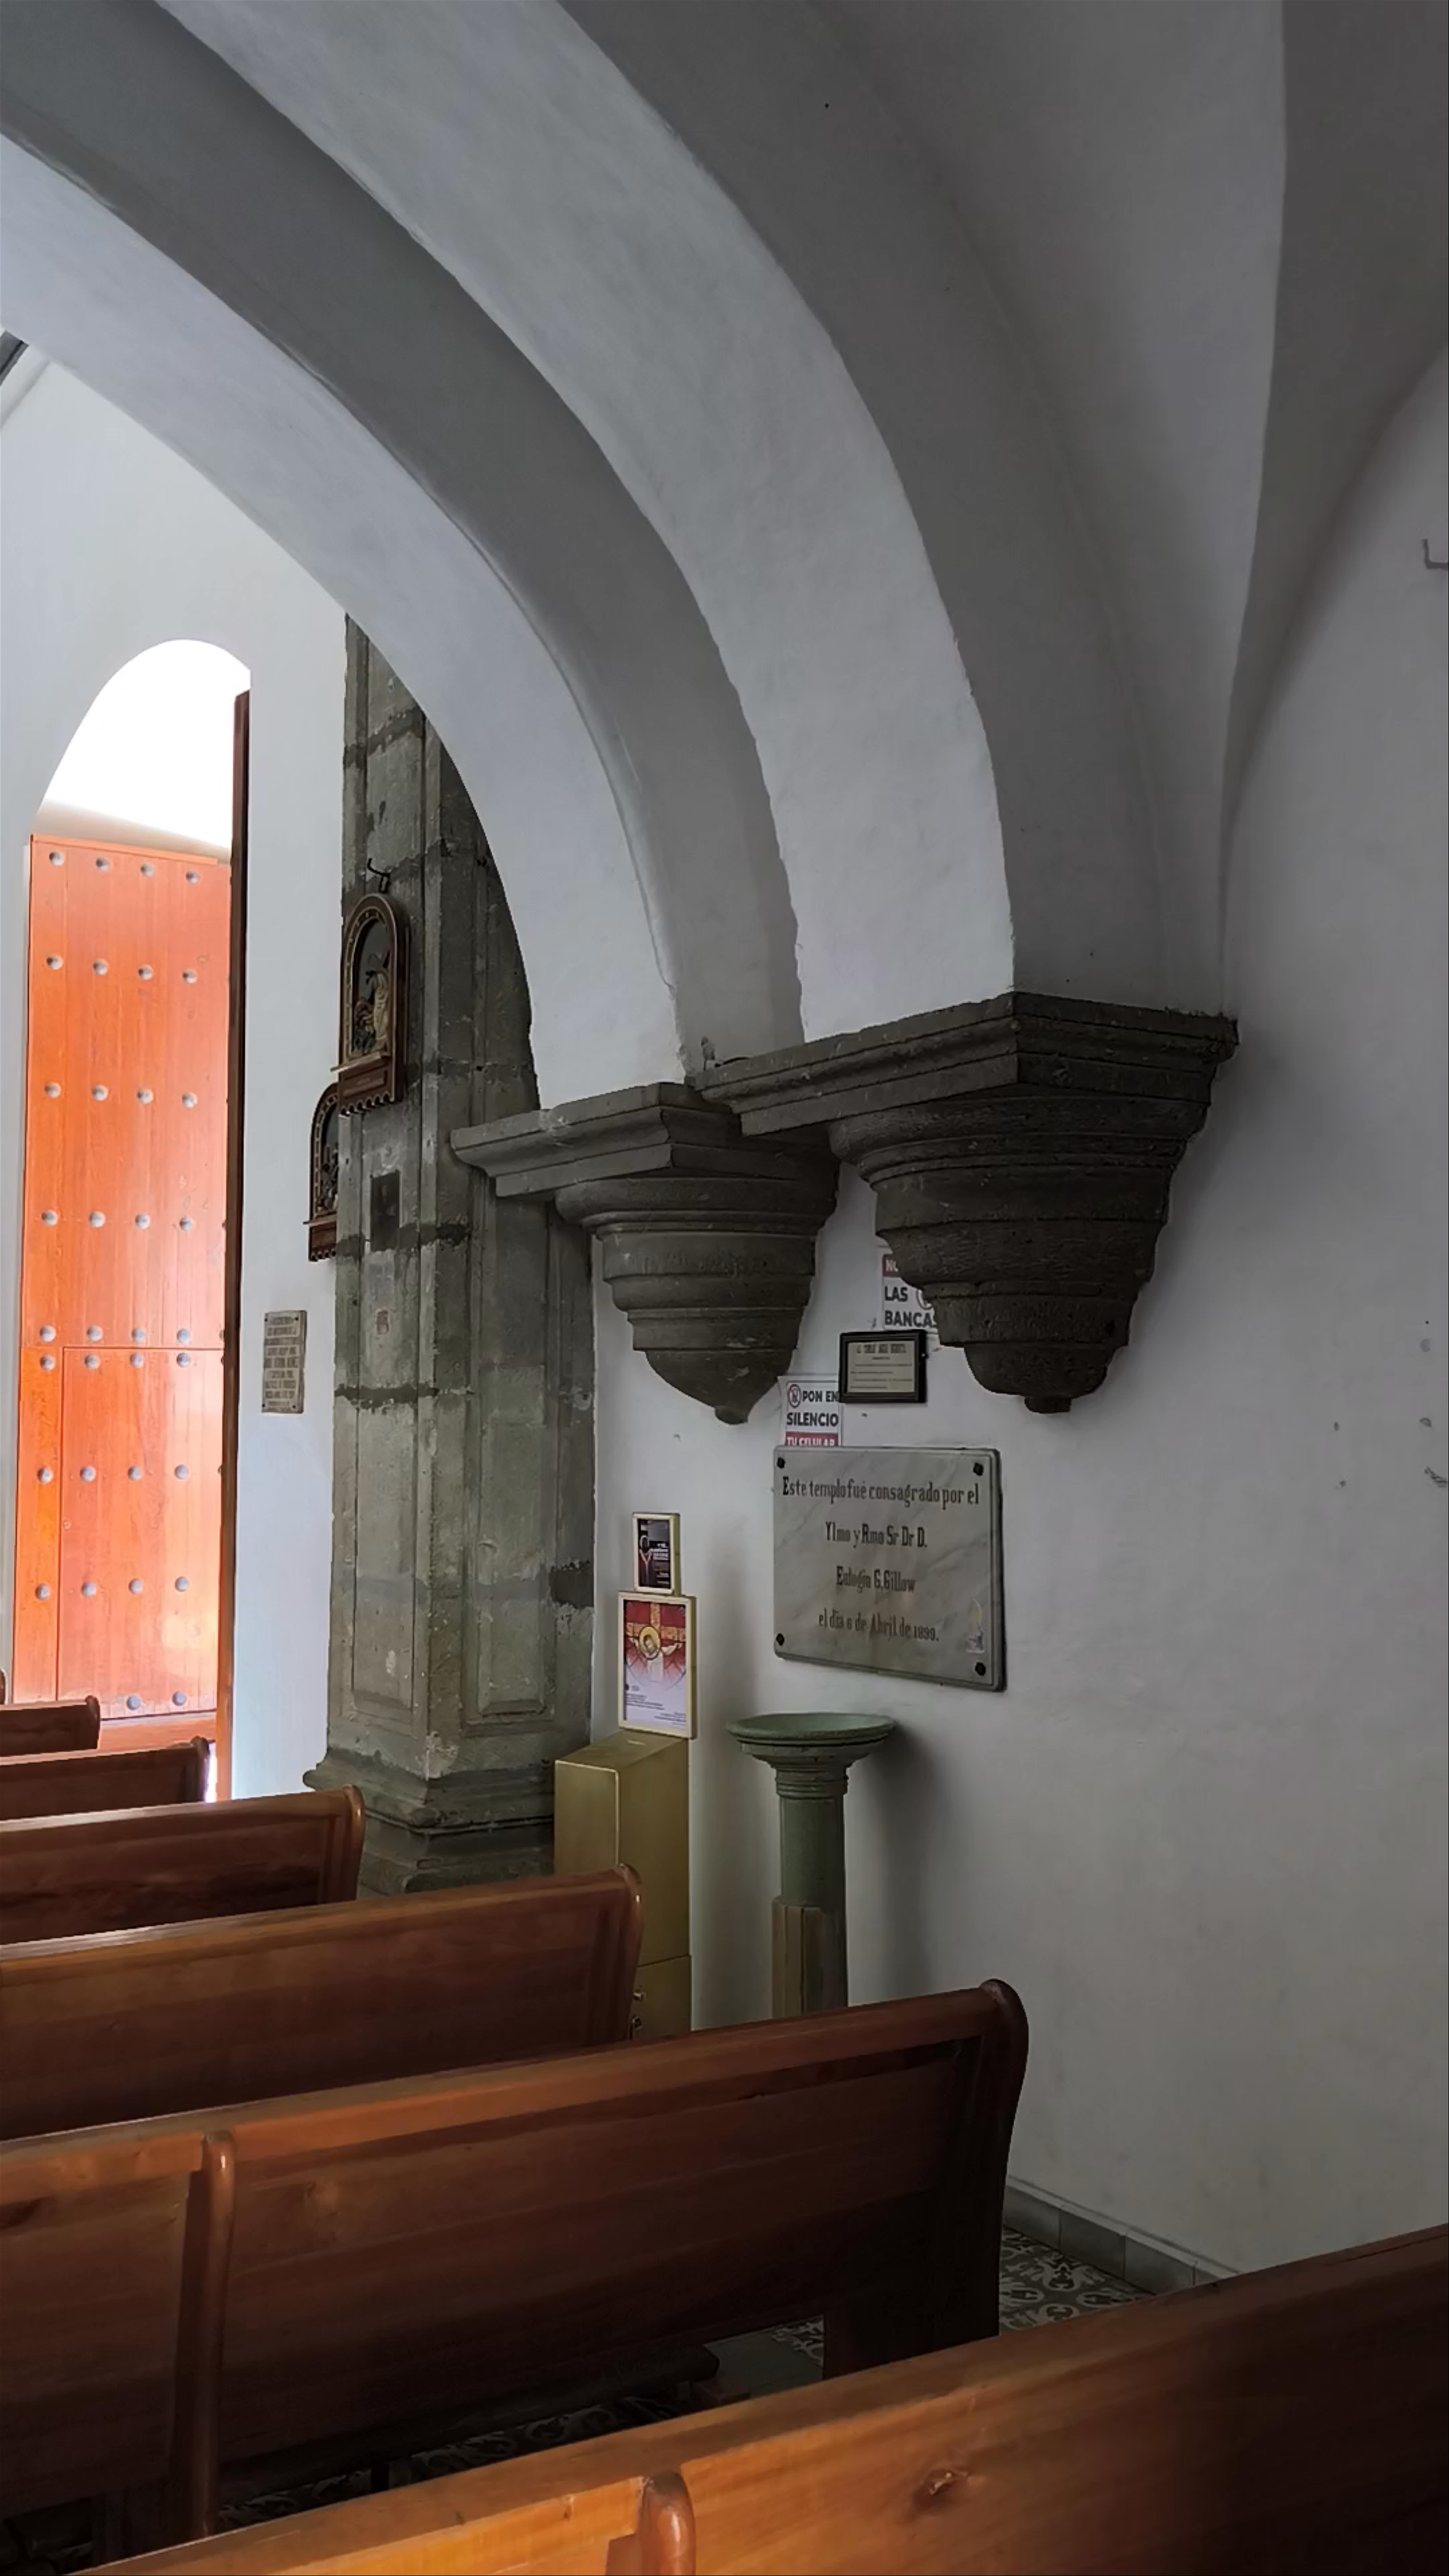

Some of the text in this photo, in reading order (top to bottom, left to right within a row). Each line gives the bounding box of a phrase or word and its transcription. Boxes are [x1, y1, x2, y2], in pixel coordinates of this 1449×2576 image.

[885, 1286, 908, 1302] LAS
[885, 1310, 936, 1328] BANCA
[803, 1390, 839, 1403] PON EN
[786, 1412, 839, 1427] SILENCIO
[787, 1437, 835, 1446] TU CELULAR
[783, 1476, 807, 1497] Este
[809, 1478, 846, 1504] templo
[869, 1481, 940, 1508] consagrado
[942, 1488, 964, 1510] por
[968, 1483, 979, 1504] el
[853, 1529, 860, 1549] y
[819, 1607, 828, 1628] el
[855, 1611, 867, 1632] de
[869, 1612, 897, 1637] Abril
[899, 1616, 911, 1638] de
